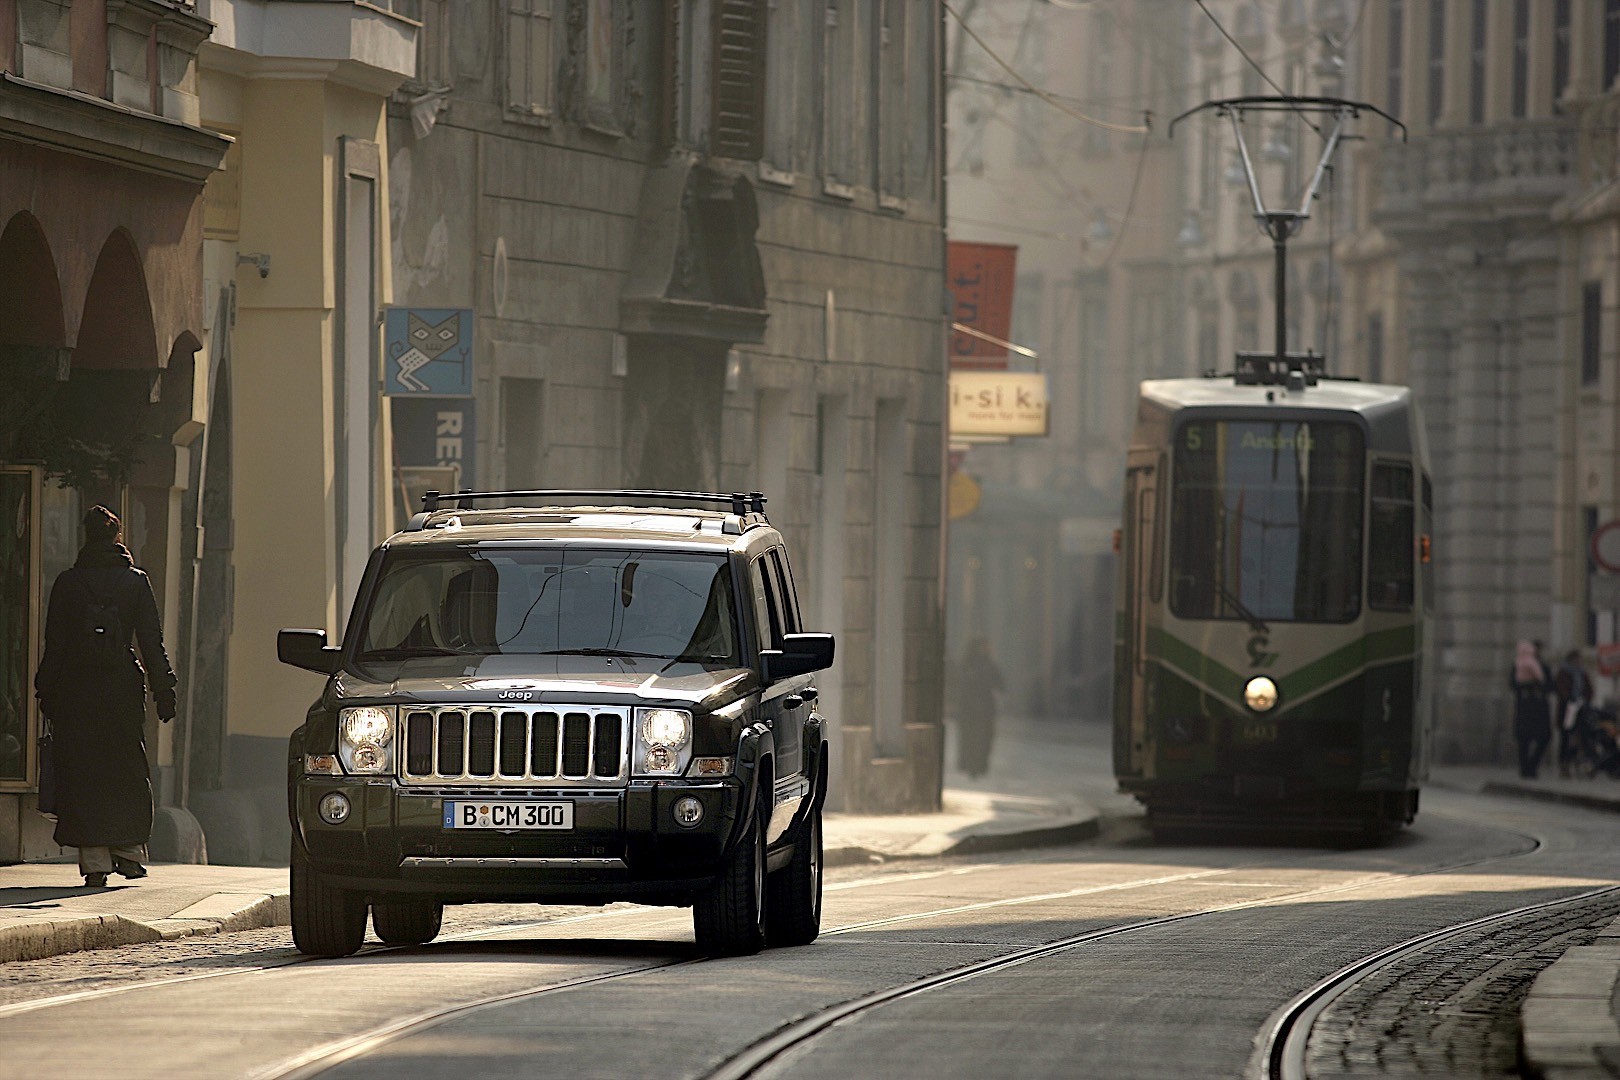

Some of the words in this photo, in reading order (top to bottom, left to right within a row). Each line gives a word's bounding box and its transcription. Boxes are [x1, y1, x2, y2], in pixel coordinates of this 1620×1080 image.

[1186, 425, 1202, 451] 5
[498, 690, 533, 701] Jeep
[463, 805, 477, 826] B
[492, 805, 520, 826] CM
[524, 805, 564, 826] 300
